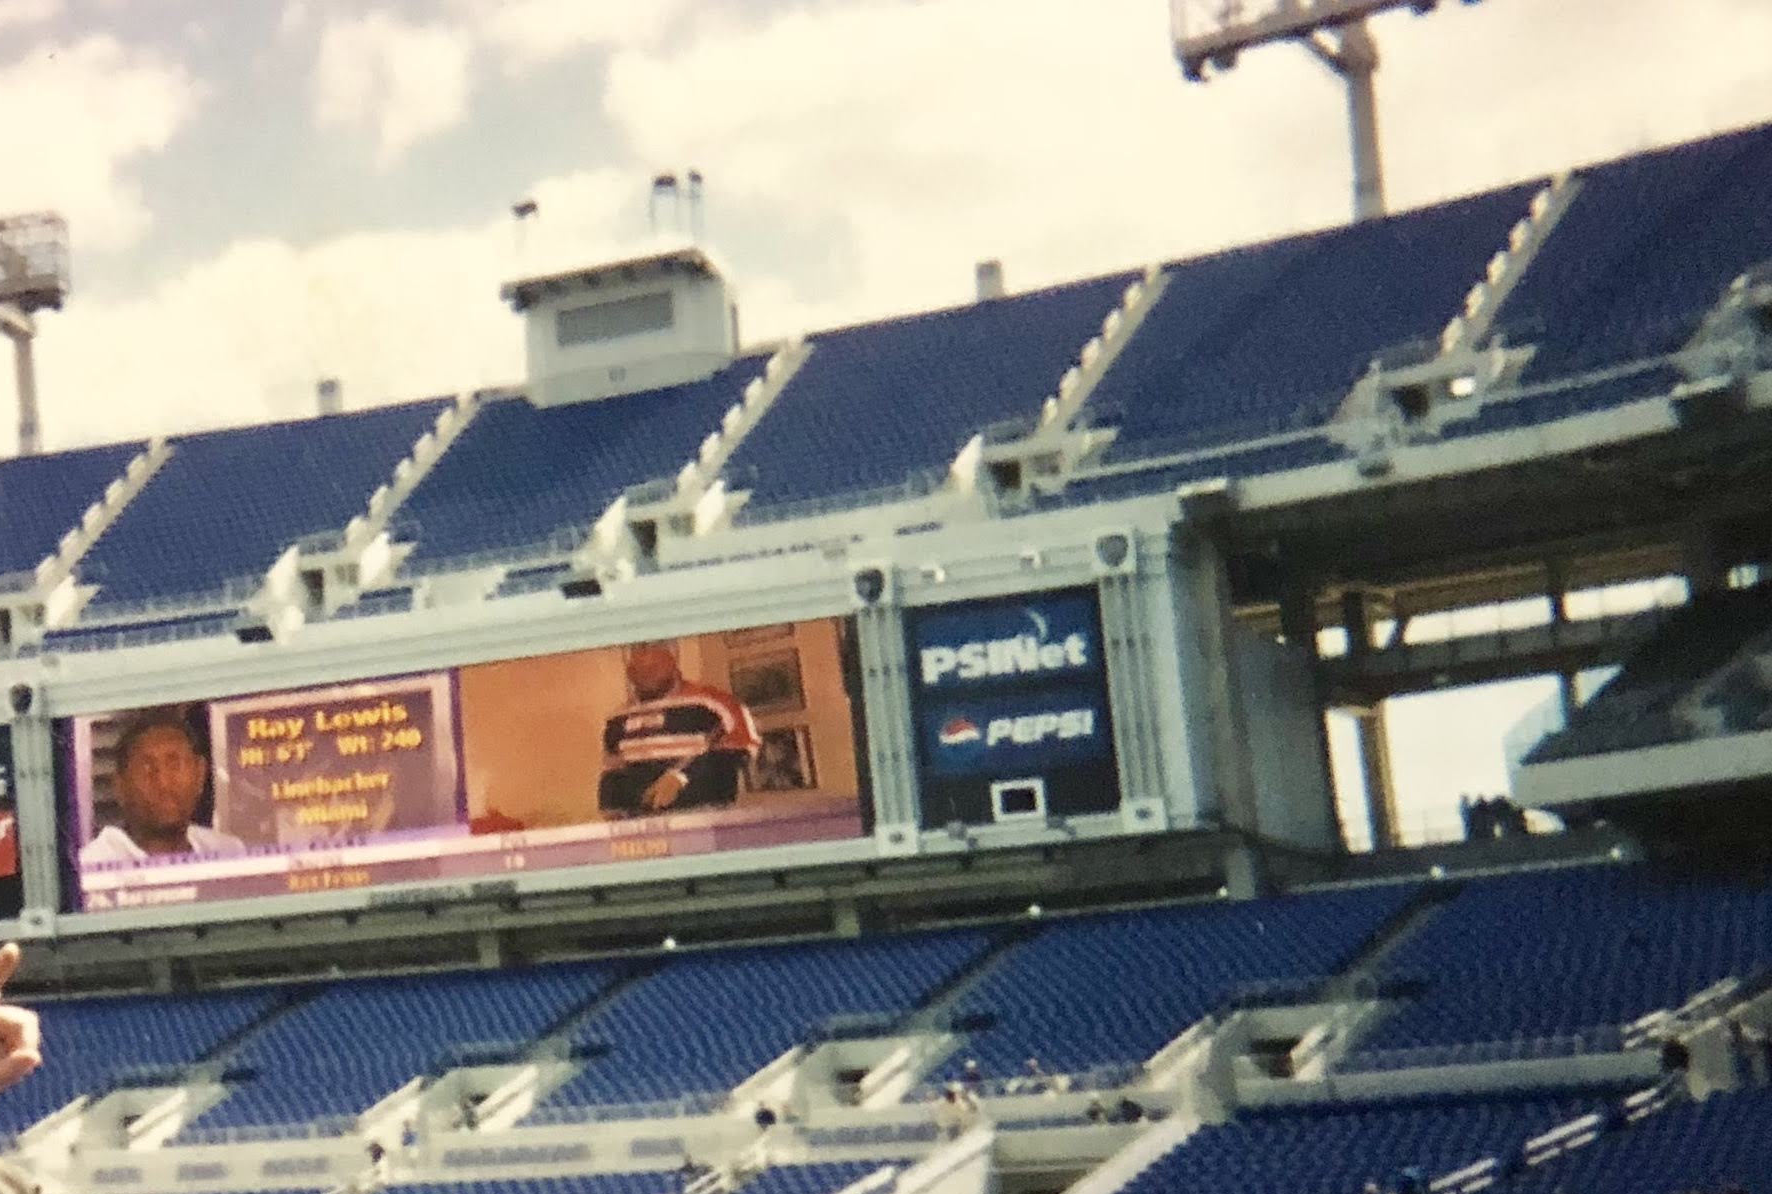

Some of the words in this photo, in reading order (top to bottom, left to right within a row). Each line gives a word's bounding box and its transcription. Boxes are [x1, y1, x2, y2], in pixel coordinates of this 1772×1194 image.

[920, 632, 1087, 686] PSINet
[247, 717, 305, 741] Ray
[315, 700, 409, 732] Lewis
[985, 708, 1095, 747] PEPSI
